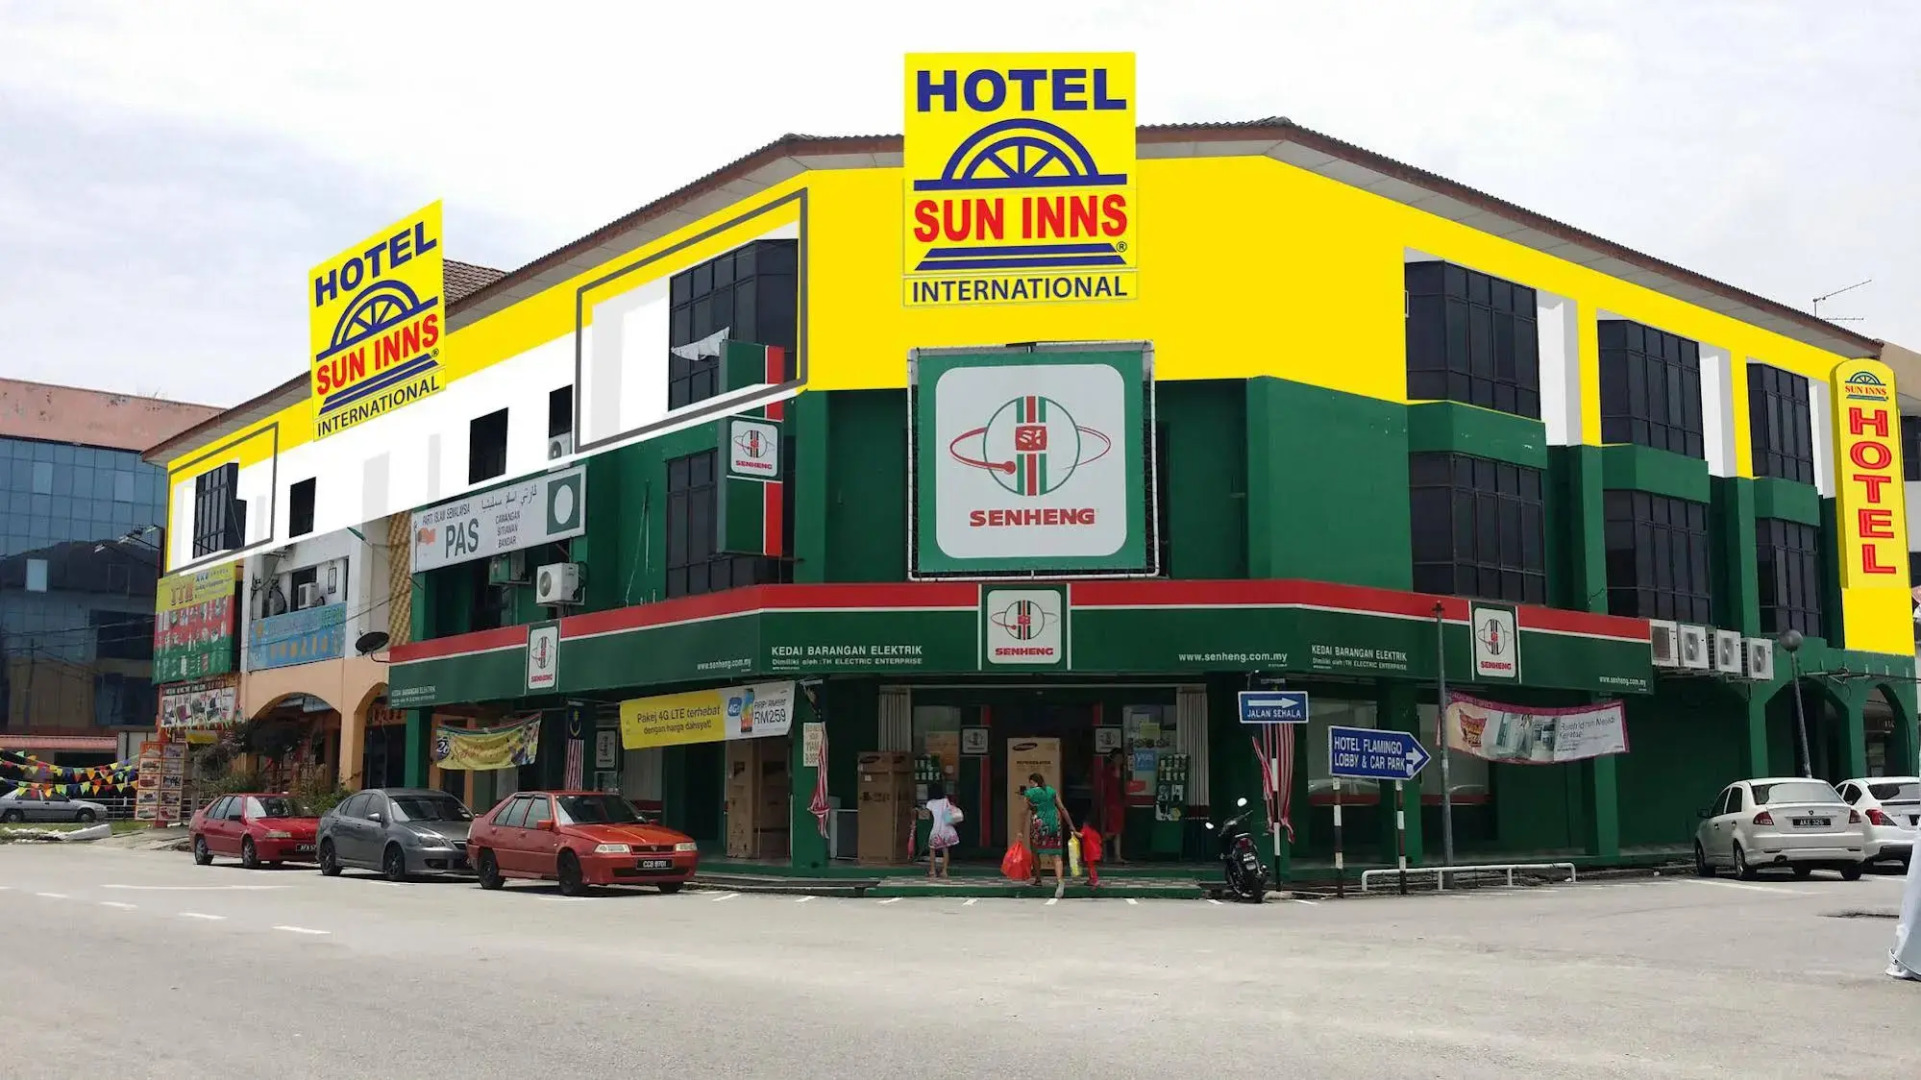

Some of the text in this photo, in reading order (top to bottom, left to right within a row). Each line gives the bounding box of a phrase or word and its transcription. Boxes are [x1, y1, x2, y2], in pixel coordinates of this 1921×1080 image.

[916, 68, 1127, 112] HOTEL
[914, 194, 1128, 243] SUN INNS
[315, 221, 437, 308] HOTEL
[913, 276, 1127, 302] INTERNATIONAL
[316, 313, 439, 396] SUN INNS
[1845, 385, 1887, 396] SUN INNS
[317, 375, 440, 437] INTERNATIONAL
[736, 460, 772, 469] SENHENG
[1849, 407, 1897, 574] HOTEL
[969, 508, 1095, 527] SENHENG
[446, 518, 479, 559] PAS
[771, 645, 923, 656] KEDAI BARANGAN ELEKTRIK
[995, 648, 1054, 656] SENHENG
[1179, 652, 1288, 663] www.senheng.com.my
[1312, 645, 1407, 661] KEDAI BARANGAN ELEKTRIK
[1481, 661, 1511, 670] SENHENG
[637, 705, 720, 724] Pakej 4G LTE terhebat
[754, 708, 786, 725] RM259
[1248, 709, 1301, 718] JALAN SEHALA
[643, 725, 666, 735] dengan
[666, 723, 684, 733] harga
[1334, 736, 1402, 755] HOTEL FLAMINGO
[1334, 754, 1405, 771] LOBBY & CAR PARK
